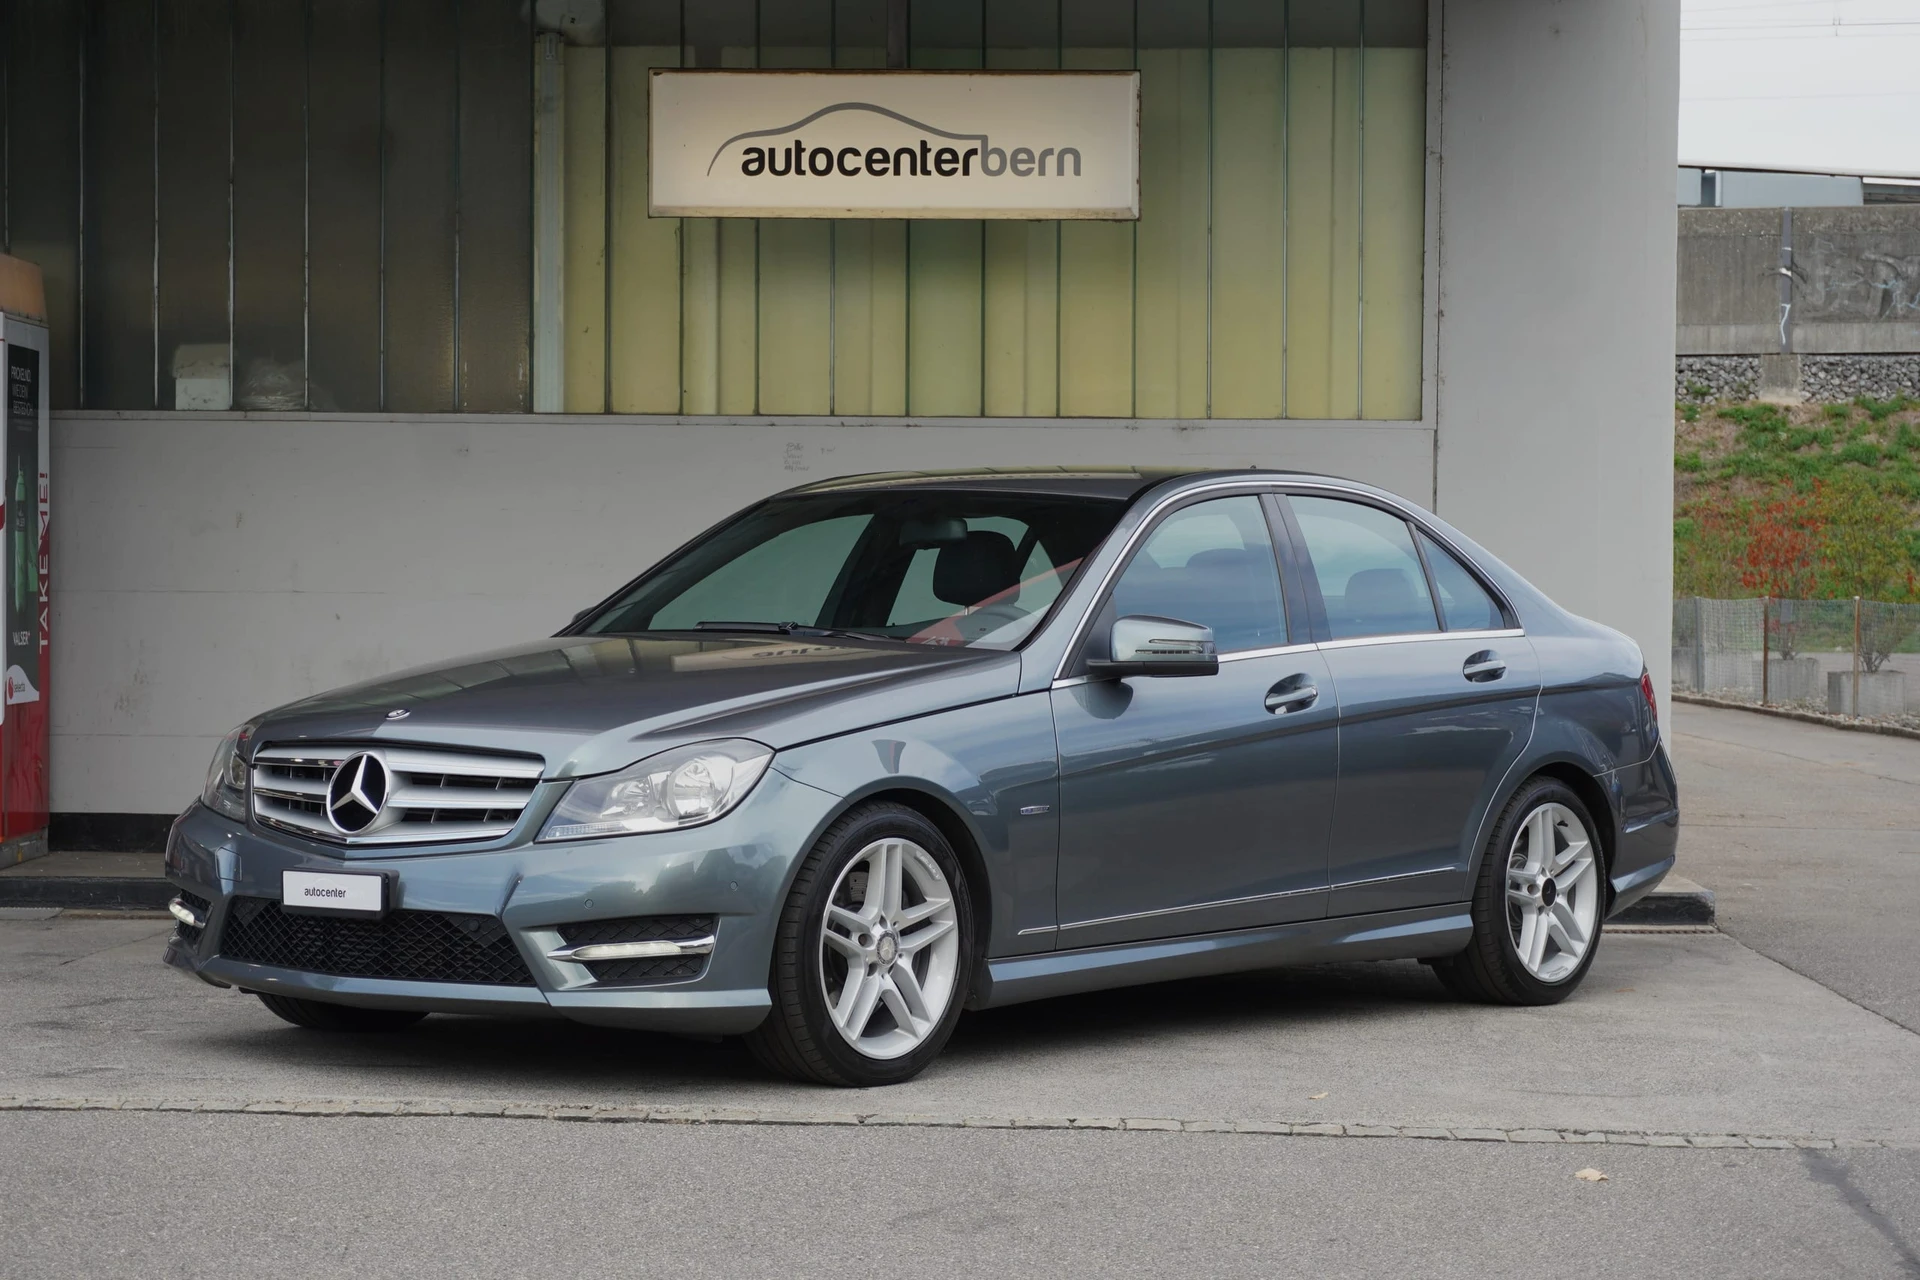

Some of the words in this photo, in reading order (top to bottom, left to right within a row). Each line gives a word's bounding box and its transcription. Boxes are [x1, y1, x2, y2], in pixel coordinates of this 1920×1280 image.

[741, 136, 1082, 177] autocenterbern
[39, 472, 48, 541] ME!
[39, 554, 48, 654] TAKE
[304, 886, 347, 898] autocenter
